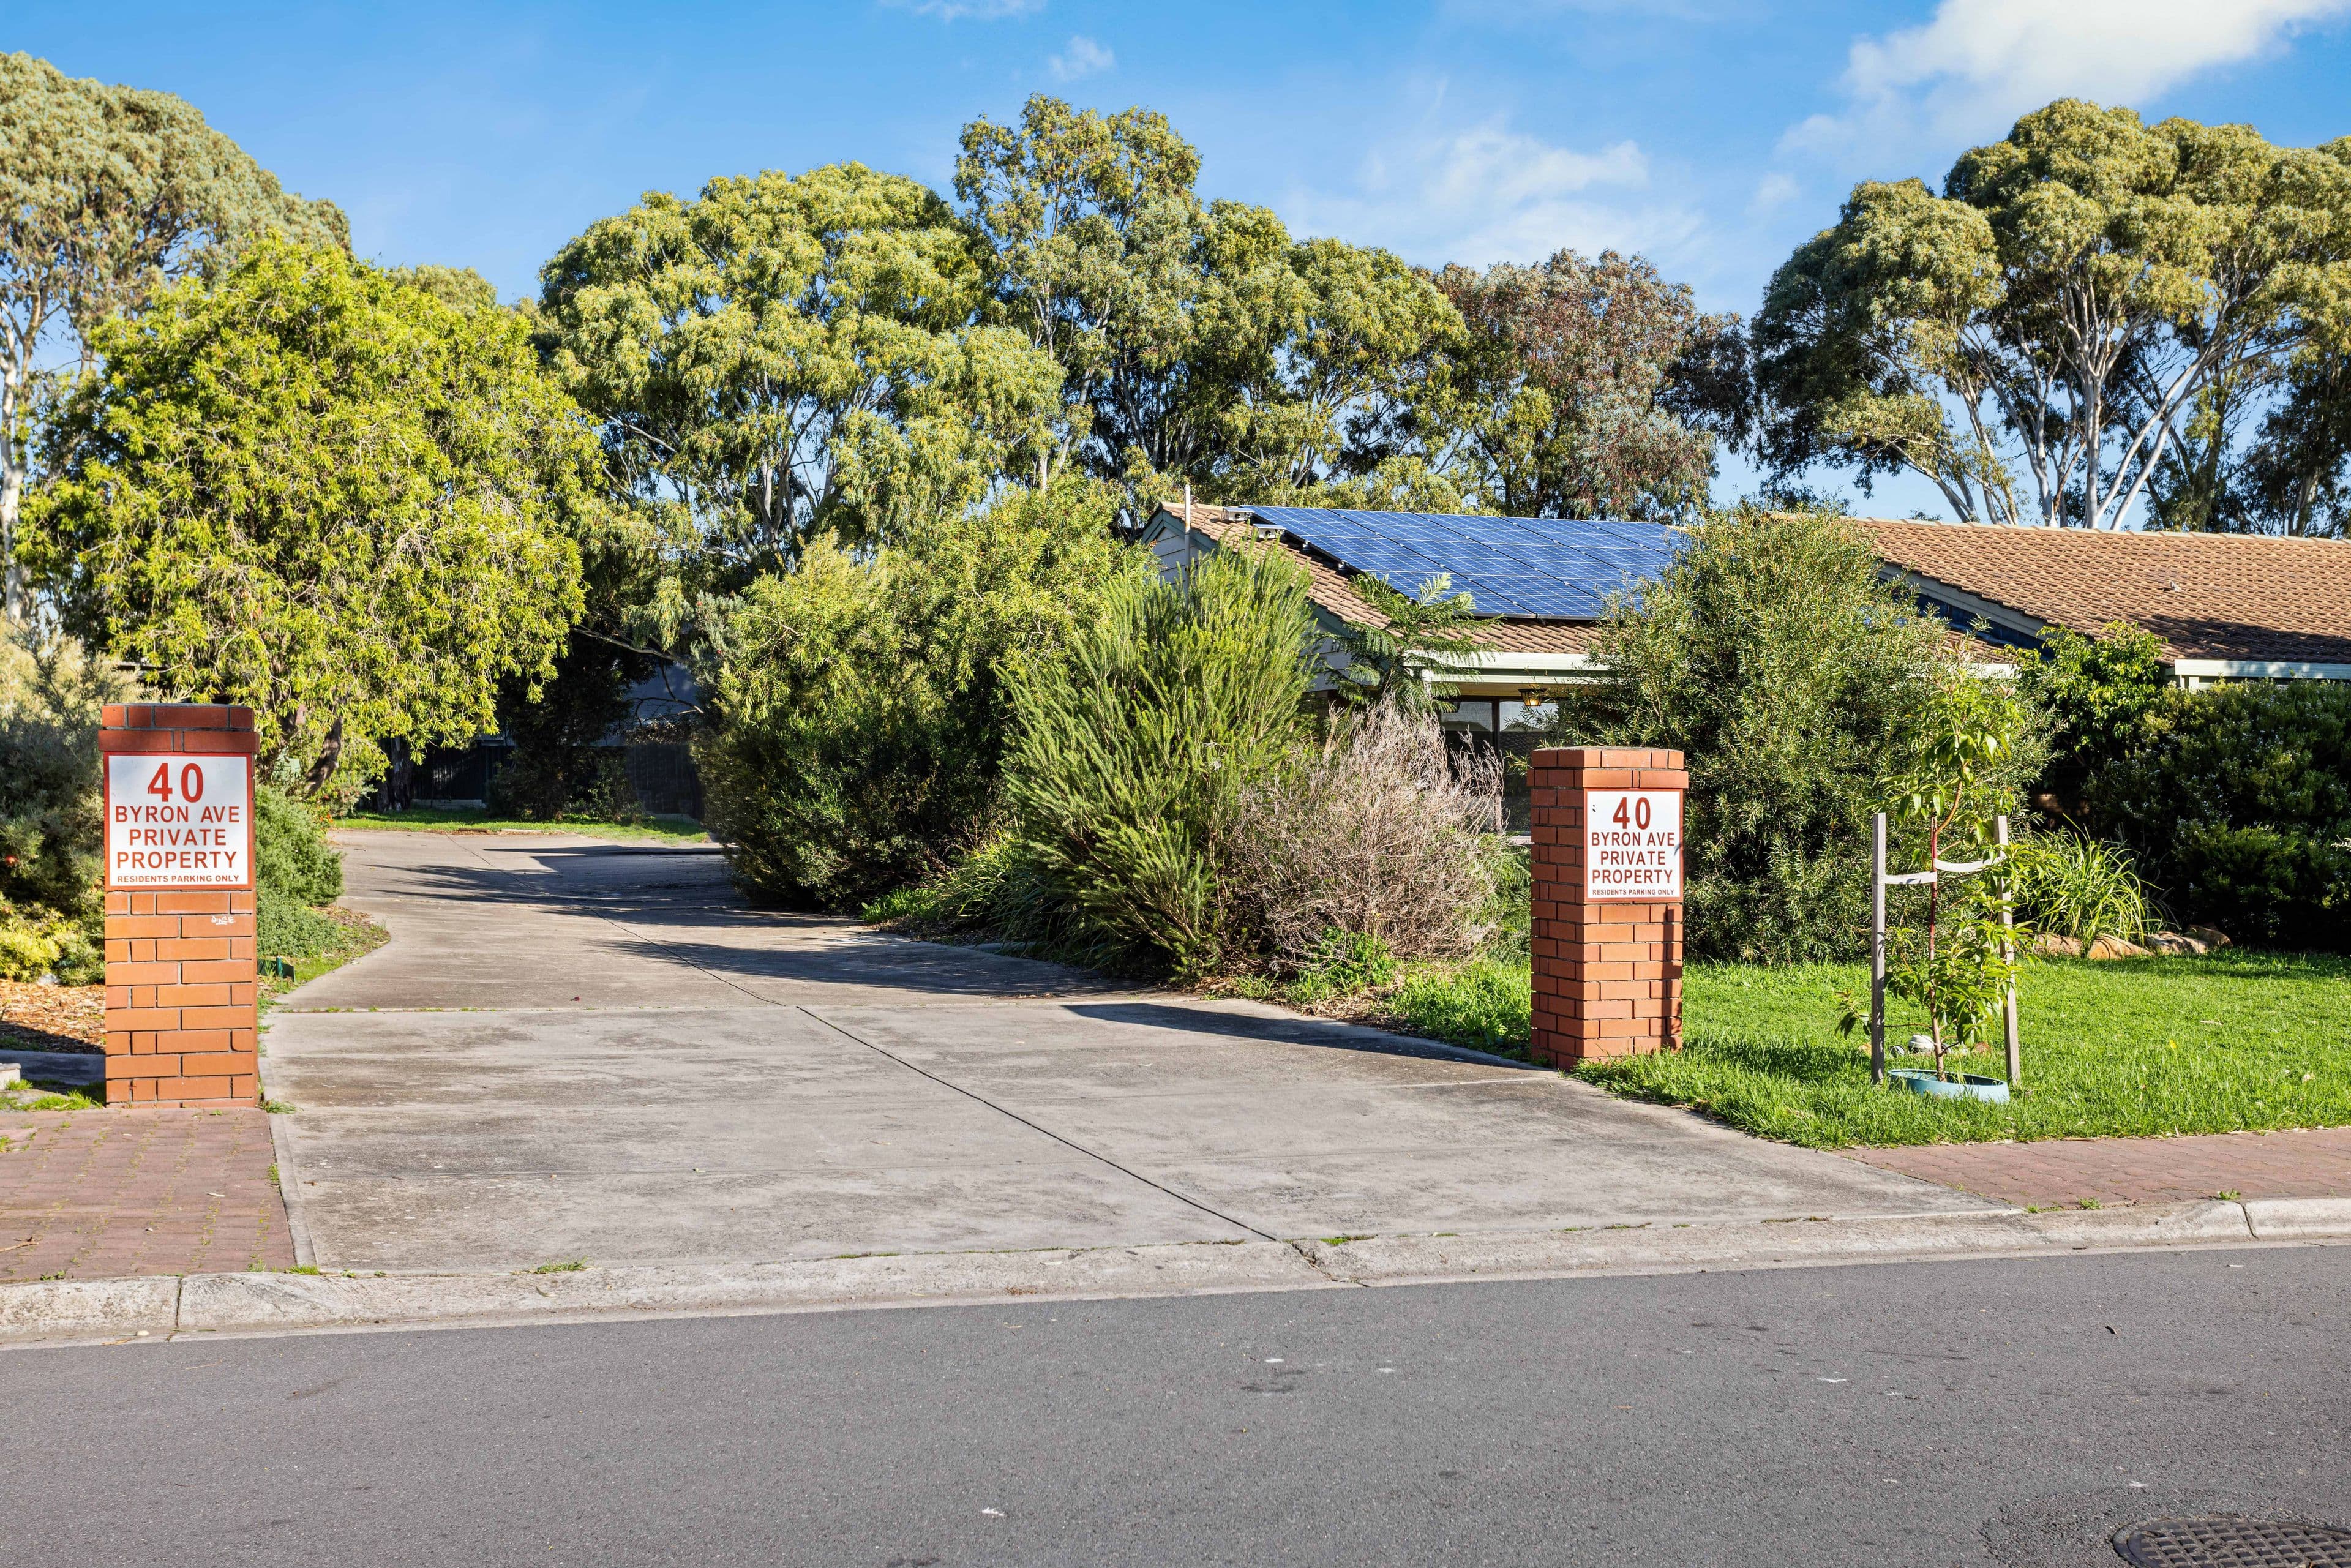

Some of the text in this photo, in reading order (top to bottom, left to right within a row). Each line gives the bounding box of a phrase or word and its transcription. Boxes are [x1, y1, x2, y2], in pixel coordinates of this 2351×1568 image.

[148, 763, 203, 803] 40
[116, 806, 239, 823] BYRON AVE
[1613, 797, 1651, 830] 40
[130, 829, 226, 846] PRIVATE
[1592, 832, 1674, 846] BYRON AVE
[118, 852, 237, 868] PROPERTY
[1600, 851, 1666, 865] PRIVATE
[1592, 869, 1673, 883] PROPERTY
